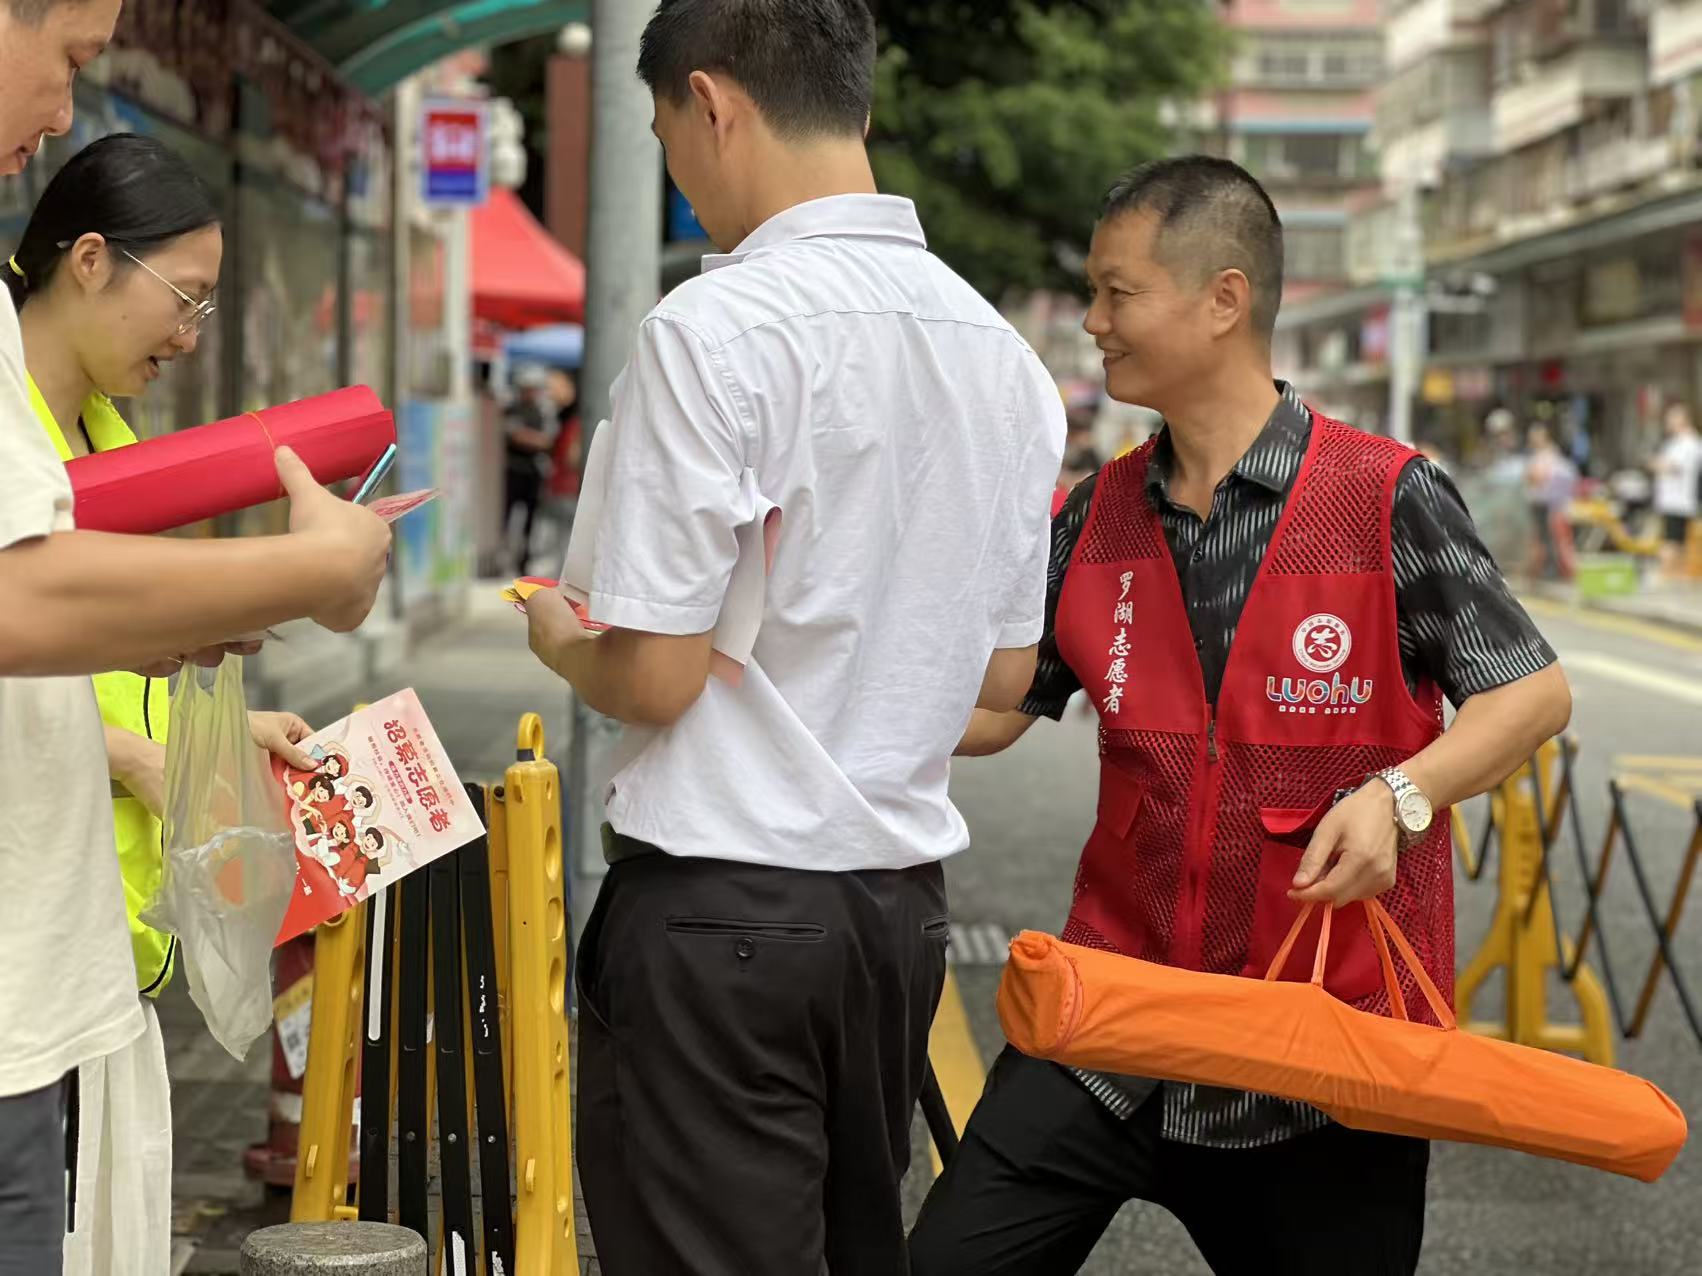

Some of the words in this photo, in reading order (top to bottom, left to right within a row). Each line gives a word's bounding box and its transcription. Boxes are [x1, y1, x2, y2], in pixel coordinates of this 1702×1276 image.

[1103, 571, 1134, 714] 罗湖志愿者
[384, 719, 451, 832] 招募志愿者
